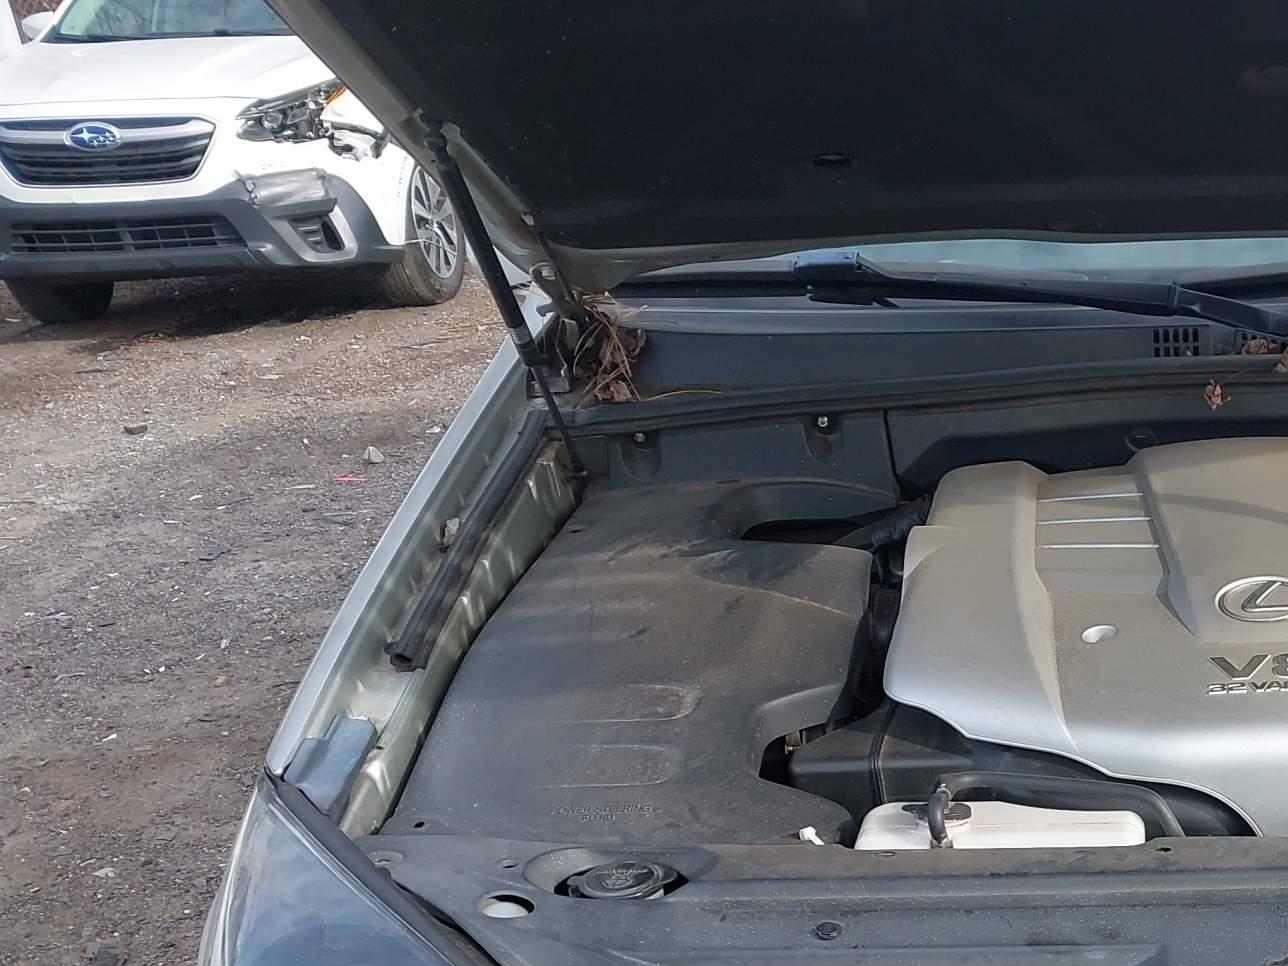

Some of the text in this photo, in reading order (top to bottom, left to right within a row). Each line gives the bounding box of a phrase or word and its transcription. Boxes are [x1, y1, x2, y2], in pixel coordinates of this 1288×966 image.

[1207, 682, 1248, 695] 32
[594, 803, 651, 814] STEERING
[581, 813, 616, 822] FLUID
